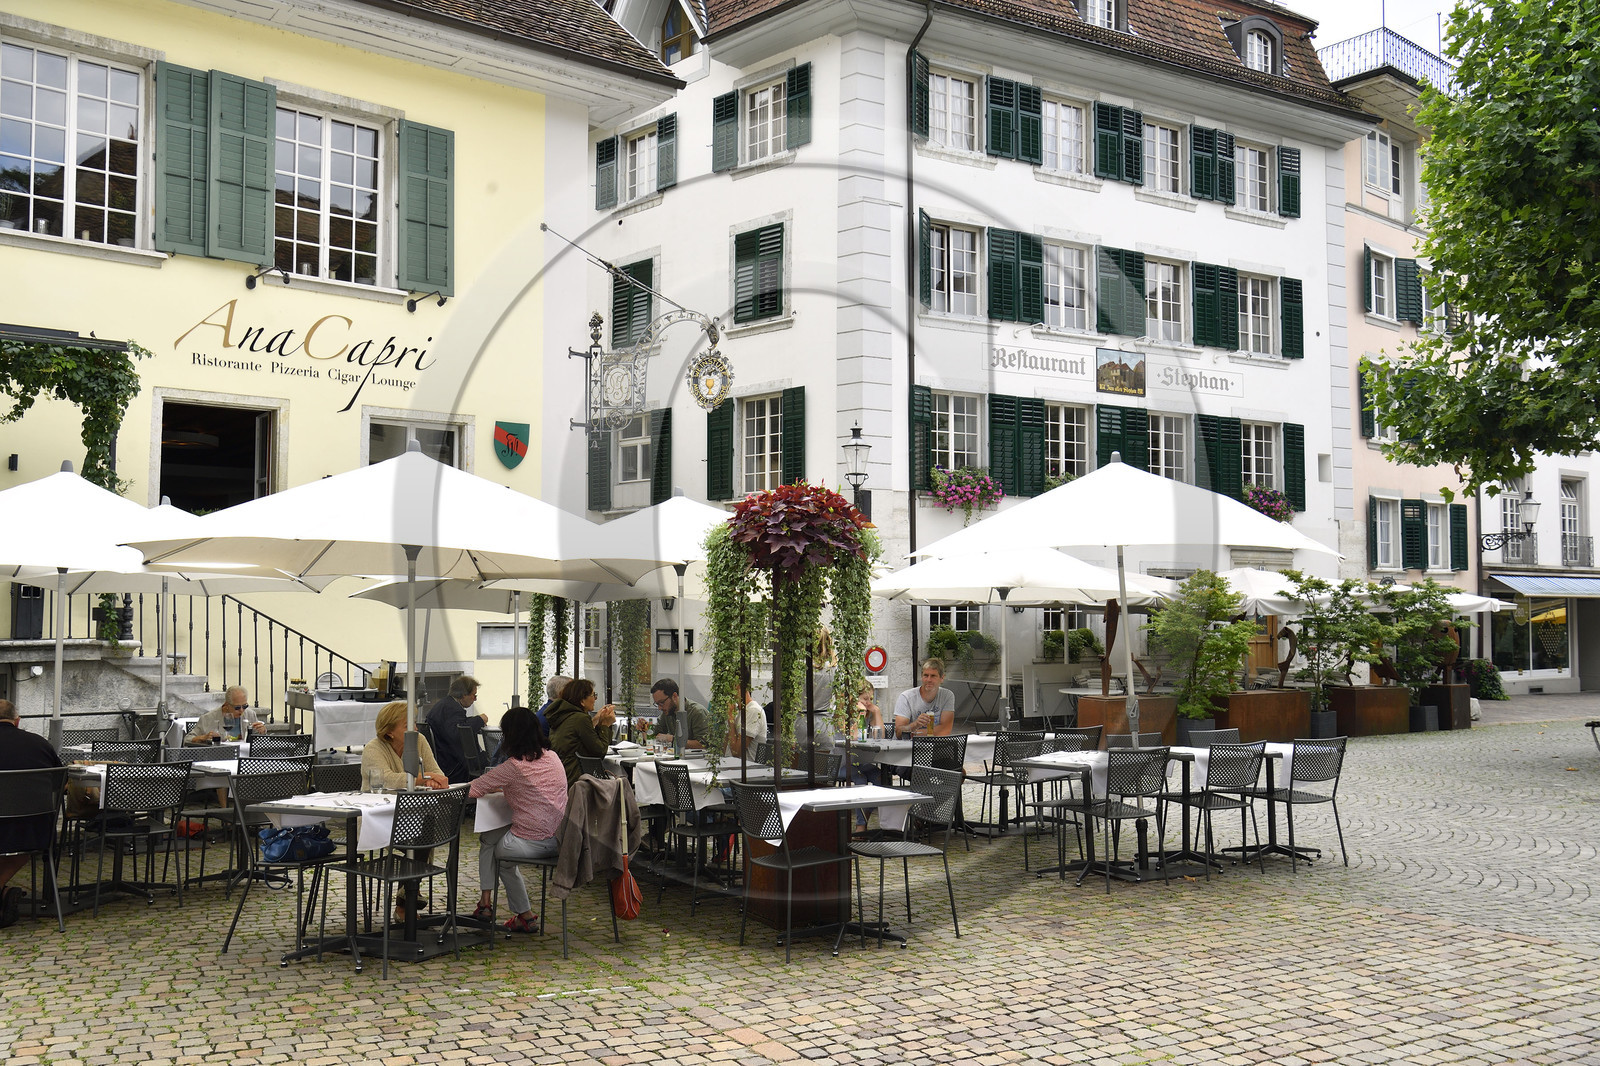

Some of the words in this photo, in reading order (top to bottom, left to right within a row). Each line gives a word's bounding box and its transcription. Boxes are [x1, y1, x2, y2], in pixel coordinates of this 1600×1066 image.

[192, 352, 262, 372] Ristorante
[270, 361, 320, 379] Pizzeria
[328, 368, 361, 385] Cigar
[372, 373, 416, 391] Lounge
